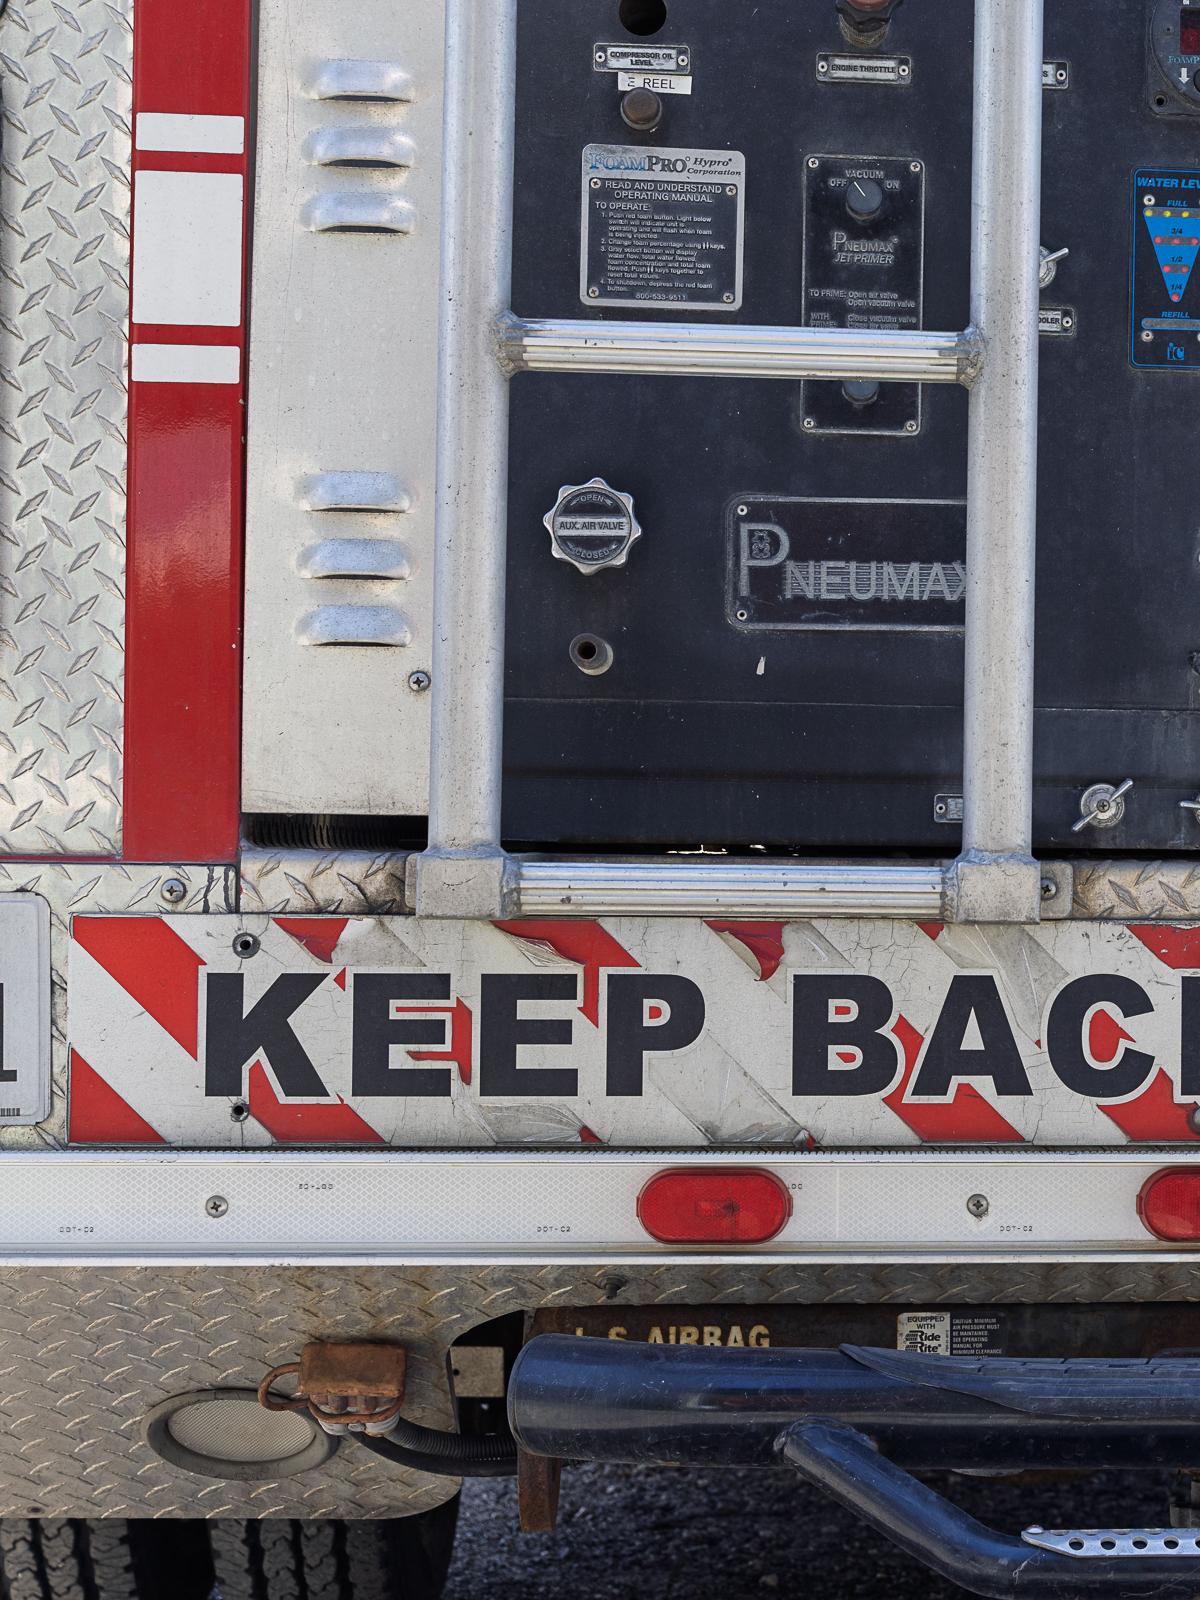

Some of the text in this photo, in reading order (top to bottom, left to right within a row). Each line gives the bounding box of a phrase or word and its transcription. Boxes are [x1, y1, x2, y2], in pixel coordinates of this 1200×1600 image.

[609, 51, 660, 59] COMPRESSOR
[831, 64, 897, 73] ENGINE THROTTLE
[643, 77, 676, 90] REEL
[692, 157, 729, 168] Hypro
[687, 167, 742, 176] Corporation
[845, 169, 884, 179] VACUUM
[605, 180, 722, 193] READ AND UNDERSTAND
[830, 179, 847, 187] OFF
[886, 181, 899, 189] ON
[1137, 177, 1179, 188] WATER
[614, 191, 713, 203] OPERATING MANUAL
[1171, 227, 1183, 235] 3/4
[833, 231, 894, 252] PNEUMAX
[834, 253, 894, 264] JET PRIMER
[1171, 283, 1182, 291] 1/4
[809, 289, 819, 297] TO
[848, 290, 867, 299] Open
[847, 299, 867, 307] Open
[868, 300, 896, 308] vacuum
[560, 522, 625, 530] AUX. AIR VALVE
[574, 549, 610, 559] CLOSED
[205, 972, 706, 1098] KEEP
[907, 1315, 945, 1323] EQUIPPED
[648, 1325, 770, 1348] AIRBAG
[909, 1330, 941, 1341] Ride
[909, 1342, 939, 1353] Rite
